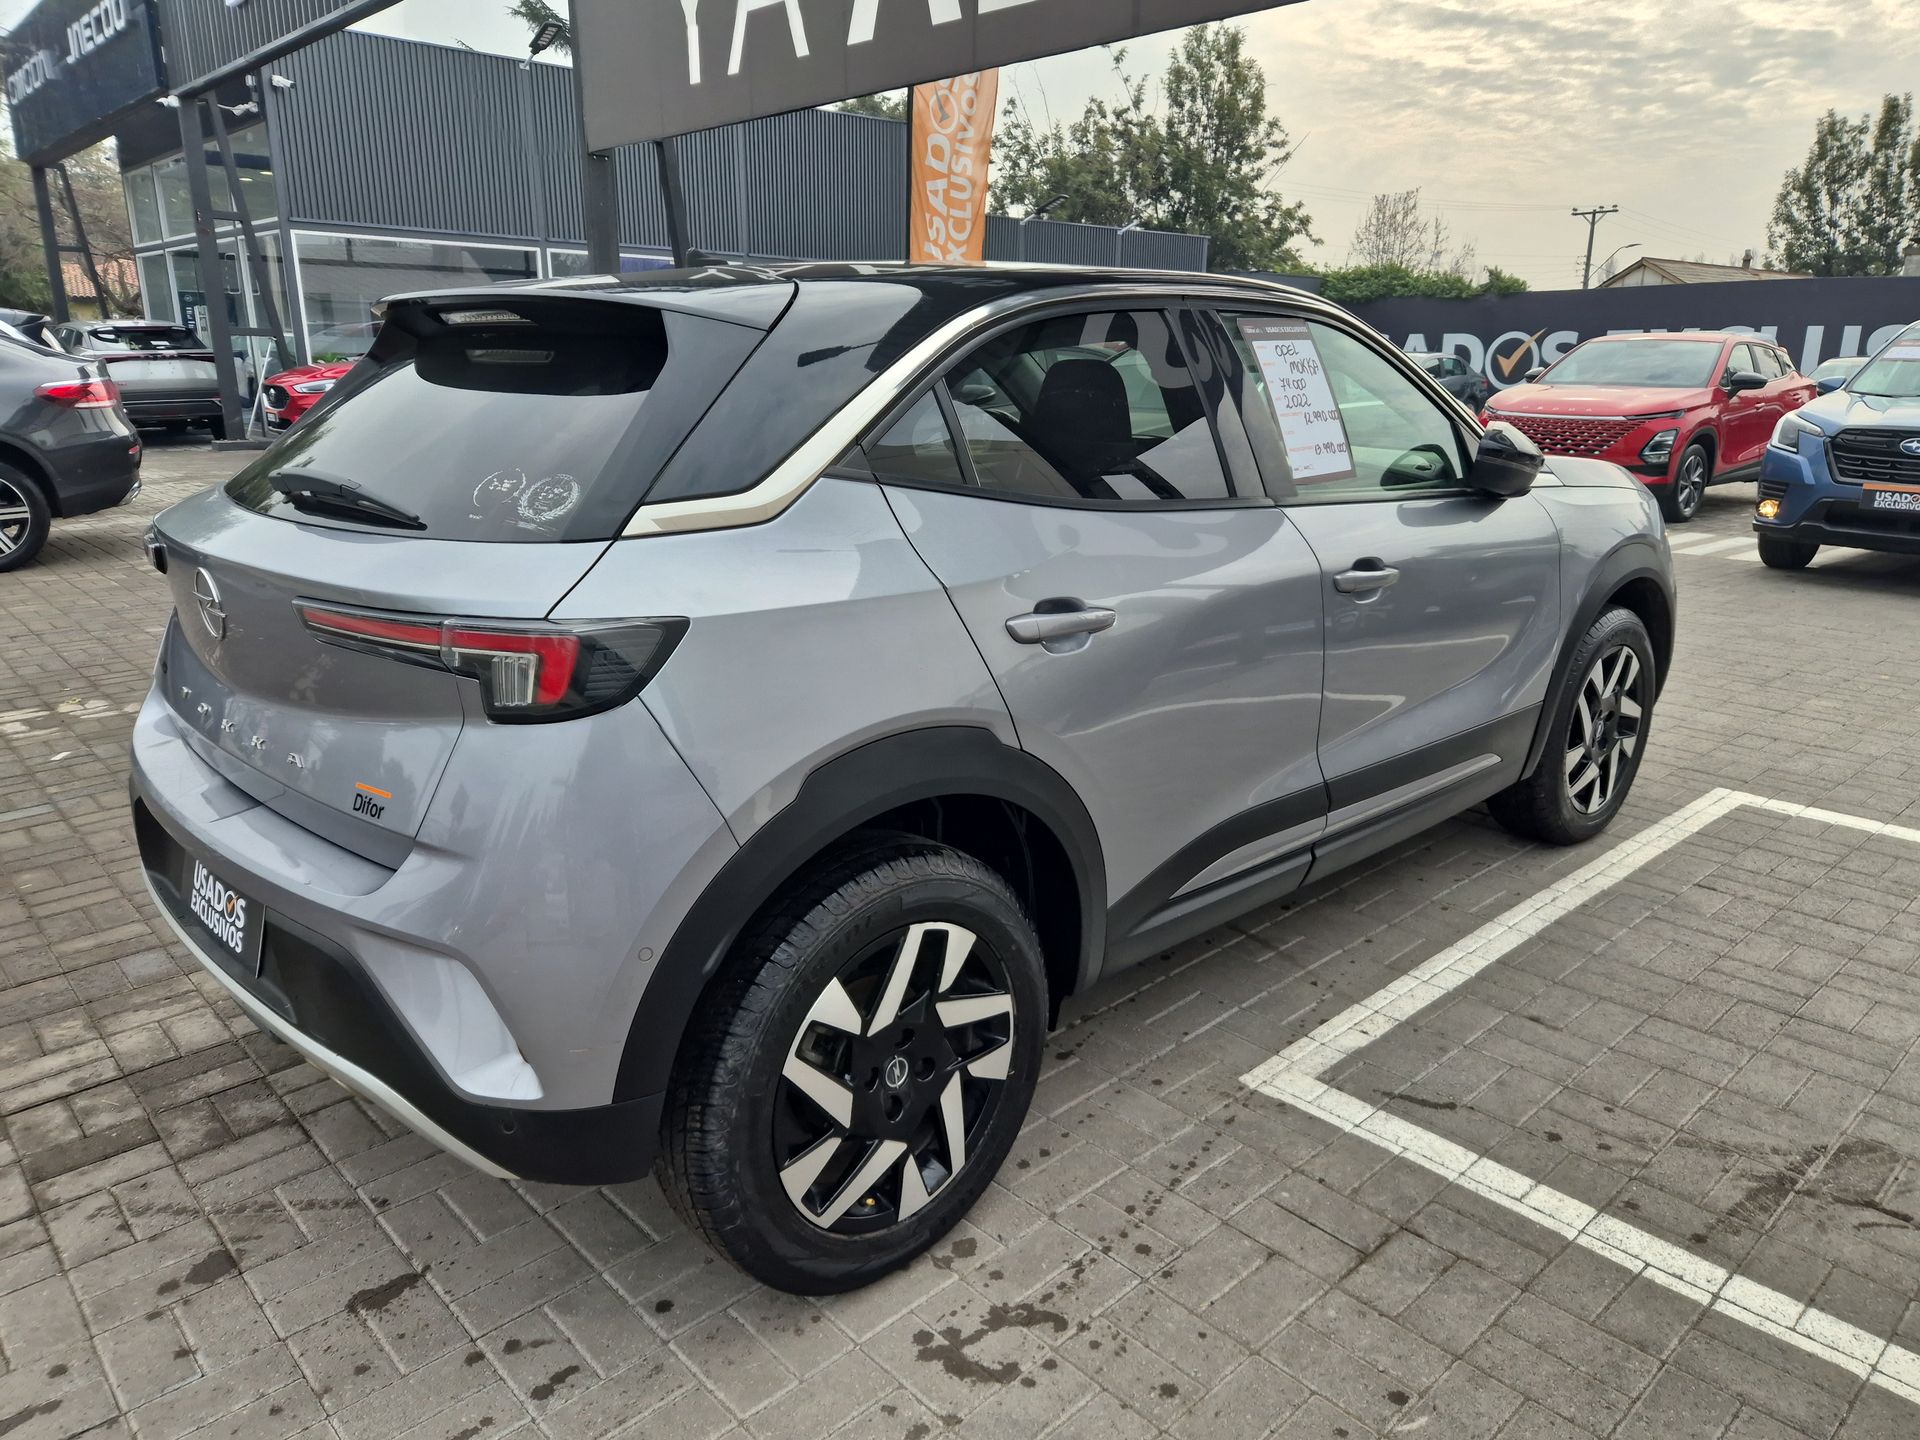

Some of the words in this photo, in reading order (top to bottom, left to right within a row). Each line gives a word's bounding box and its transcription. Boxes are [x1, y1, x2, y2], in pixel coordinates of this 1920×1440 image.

[1290, 358, 1319, 376] MOKKA
[1284, 393, 1311, 409] 2022
[1874, 500, 1920, 511] EXCLUSIVO
[1876, 491, 1920, 504] USADO
[352, 793, 385, 819] Difor
[193, 859, 247, 929] USADOS
[190, 888, 244, 953] EXCLUSIVOS
